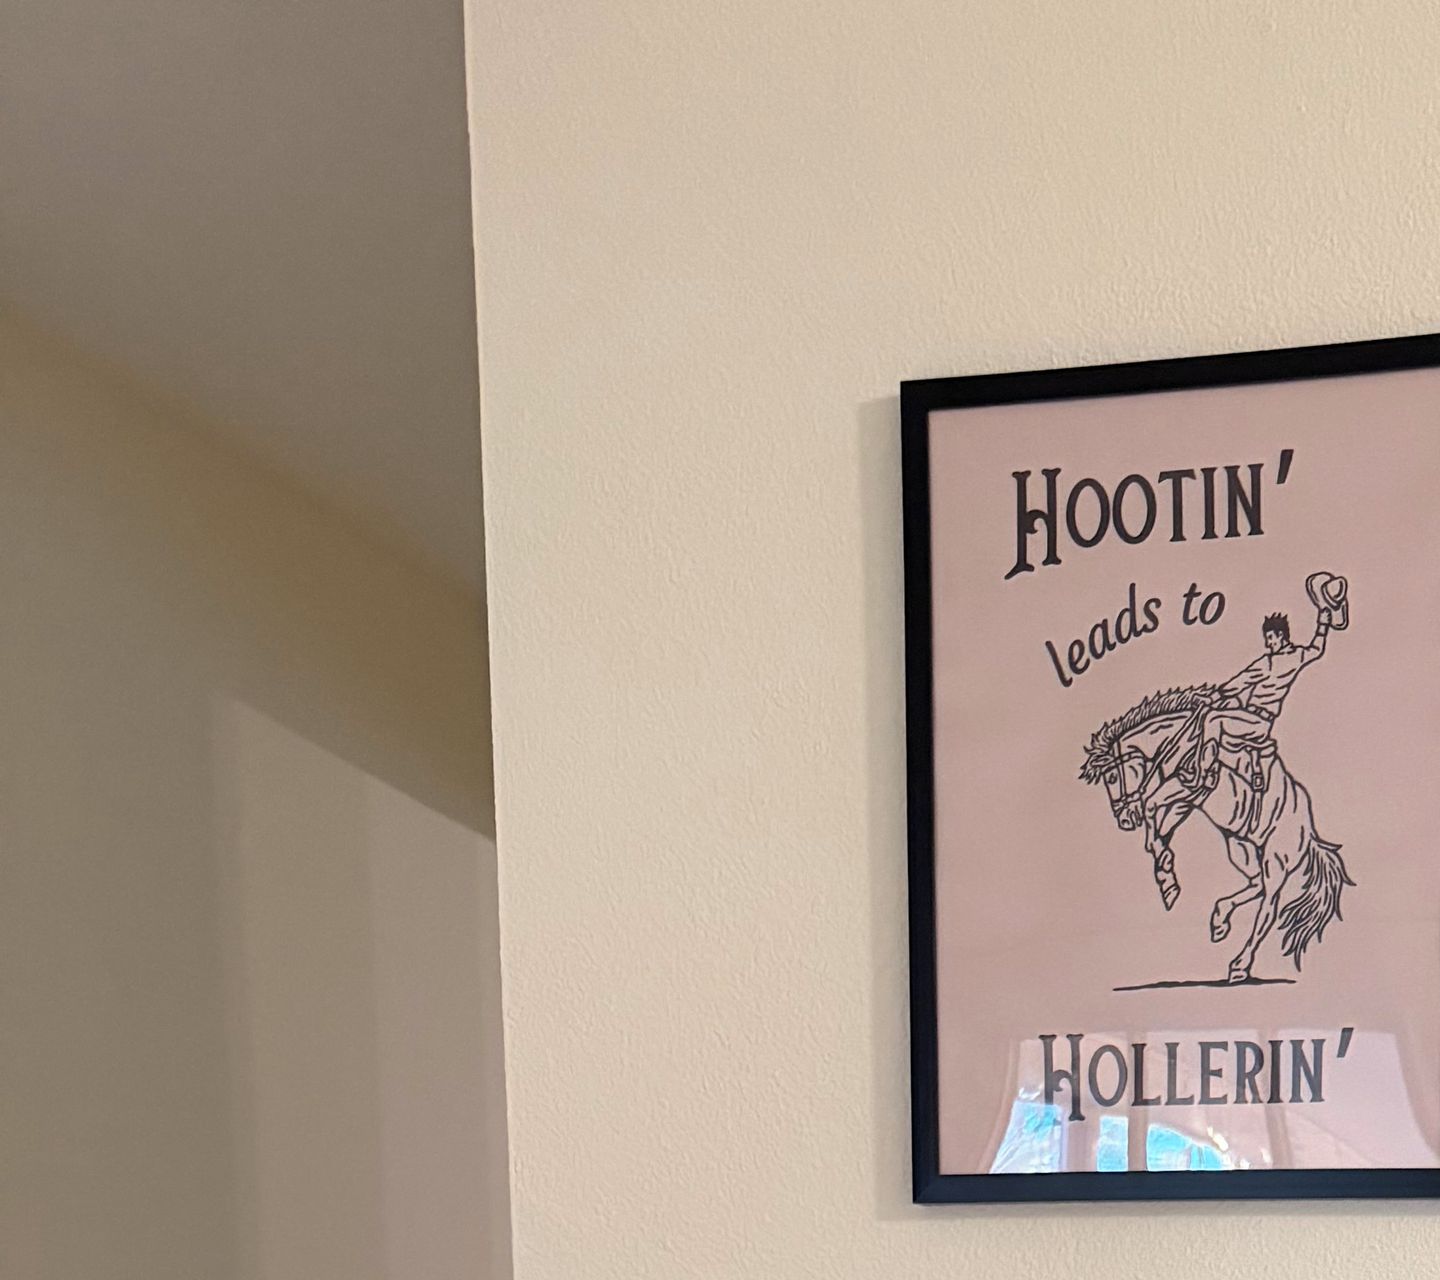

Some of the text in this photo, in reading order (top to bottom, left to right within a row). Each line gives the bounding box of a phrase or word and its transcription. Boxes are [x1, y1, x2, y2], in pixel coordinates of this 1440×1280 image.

[1004, 449, 1295, 581] HOOTIN'
[1045, 582, 1226, 688] leads to
[1038, 1027, 1355, 1122] HOLLERIN'
